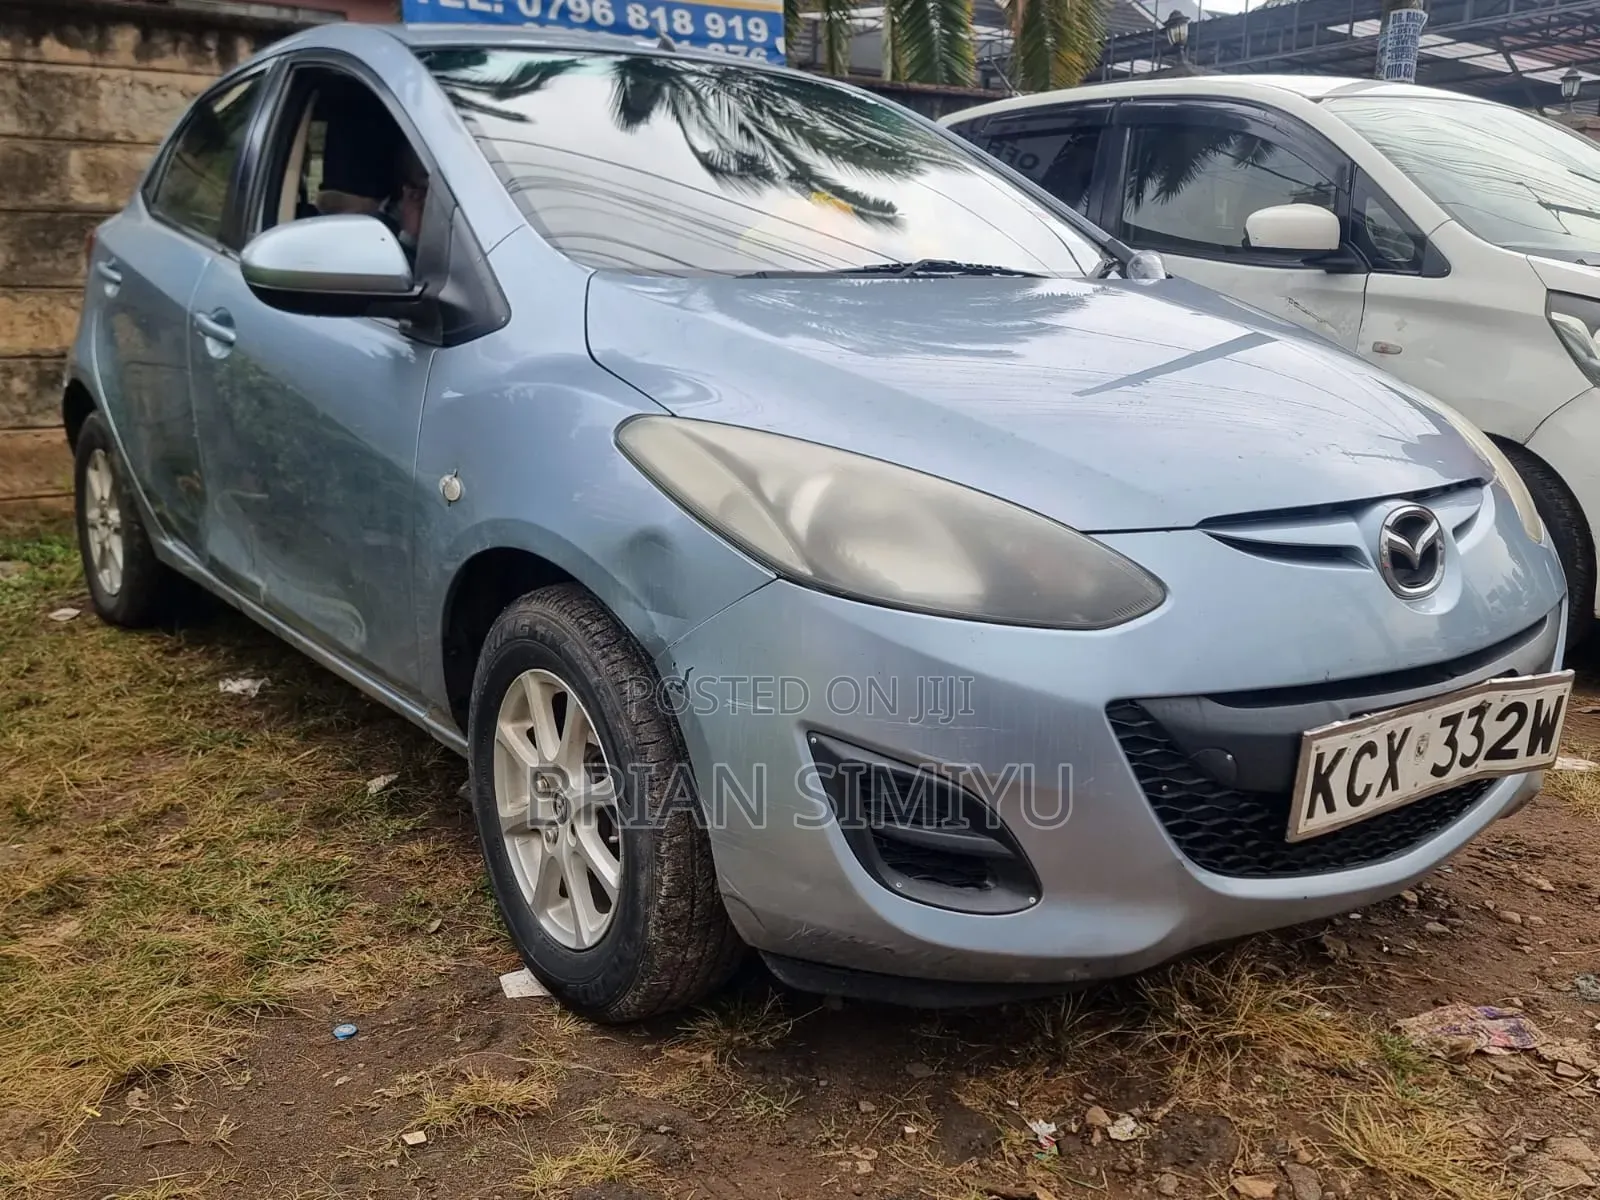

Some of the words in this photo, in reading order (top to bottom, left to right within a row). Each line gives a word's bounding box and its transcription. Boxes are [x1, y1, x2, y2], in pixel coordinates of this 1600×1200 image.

[518, 0, 615, 27] 0796
[626, 3, 694, 36] 818
[704, 12, 769, 43] 919
[1306, 726, 1412, 819] KCX
[1430, 695, 1565, 778] 332W
